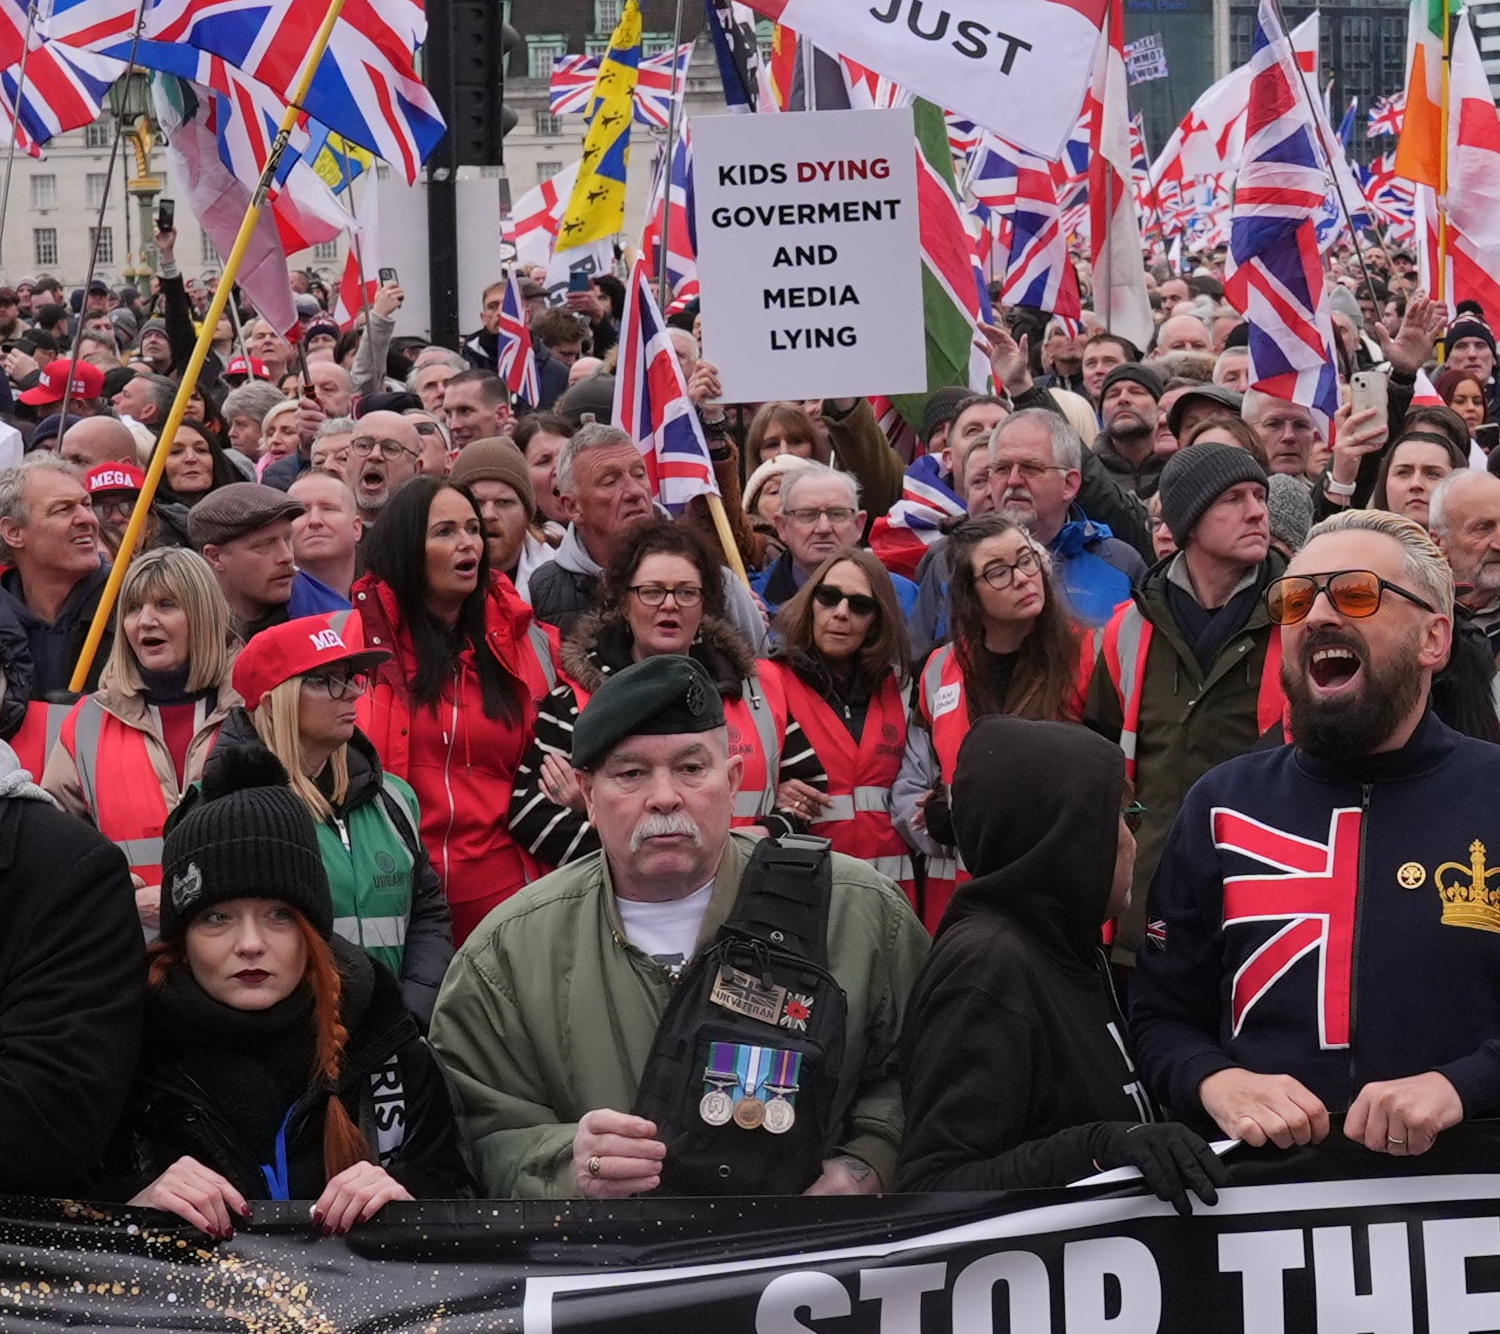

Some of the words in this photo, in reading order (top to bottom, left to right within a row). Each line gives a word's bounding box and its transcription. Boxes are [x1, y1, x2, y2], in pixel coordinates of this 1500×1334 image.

[718, 163, 788, 186] KIDS
[796, 158, 891, 183] DYING
[711, 199, 902, 229] GOVERMENT
[772, 244, 838, 268] AND
[763, 285, 860, 309] MEDIA
[770, 326, 857, 351] LYING
[90, 470, 136, 491] MEGA
